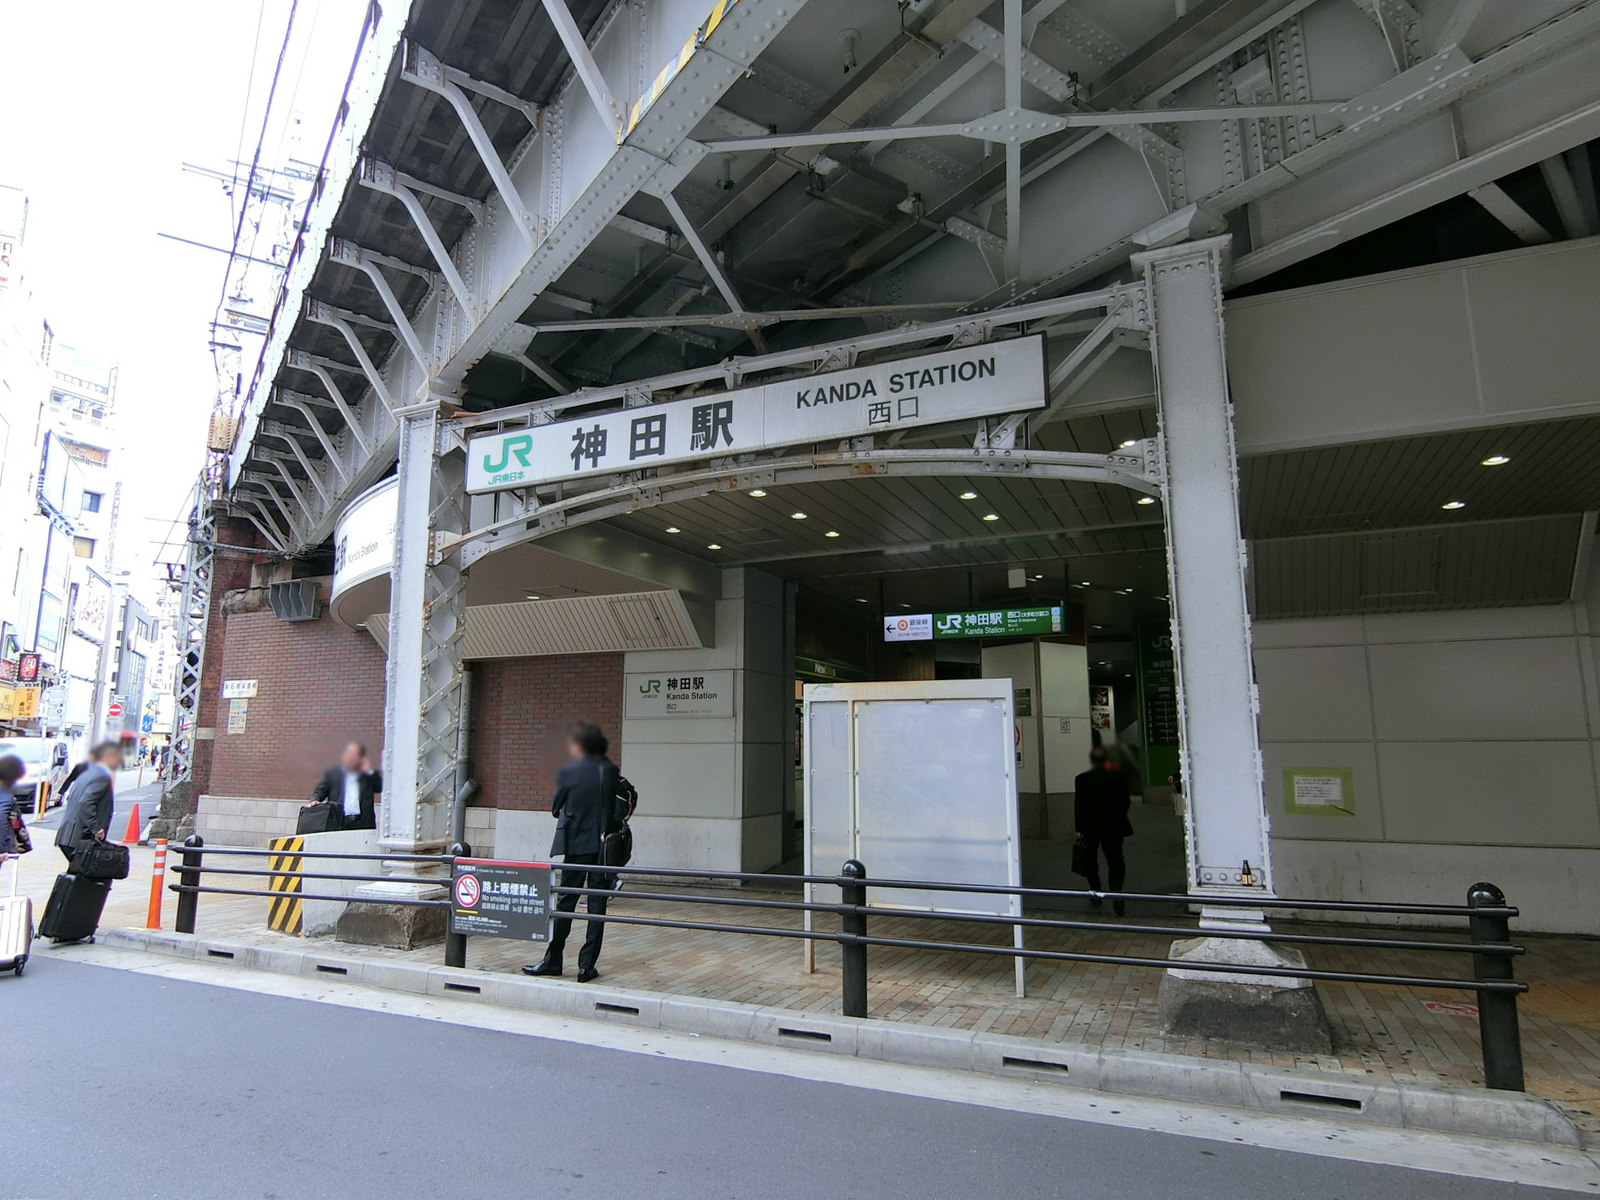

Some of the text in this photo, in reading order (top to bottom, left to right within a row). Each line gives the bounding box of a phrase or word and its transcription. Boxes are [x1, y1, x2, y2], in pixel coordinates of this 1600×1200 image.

[796, 357, 996, 410] KANDA STATION
[868, 396, 919, 426] 西口
[570, 400, 734, 470] 神田駅
[484, 434, 533, 474] JR
[488, 470, 526, 485] JR東日本
[937, 614, 963, 629] JR
[965, 612, 1003, 626] 神田駅
[640, 680, 661, 693] JR
[667, 677, 704, 690] 神田駅
[666, 691, 717, 700] Kanda Station
[482, 881, 538, 896] 路上喫煙禁止
[490, 896, 511, 904] smoking
[520, 897, 528, 905] the
